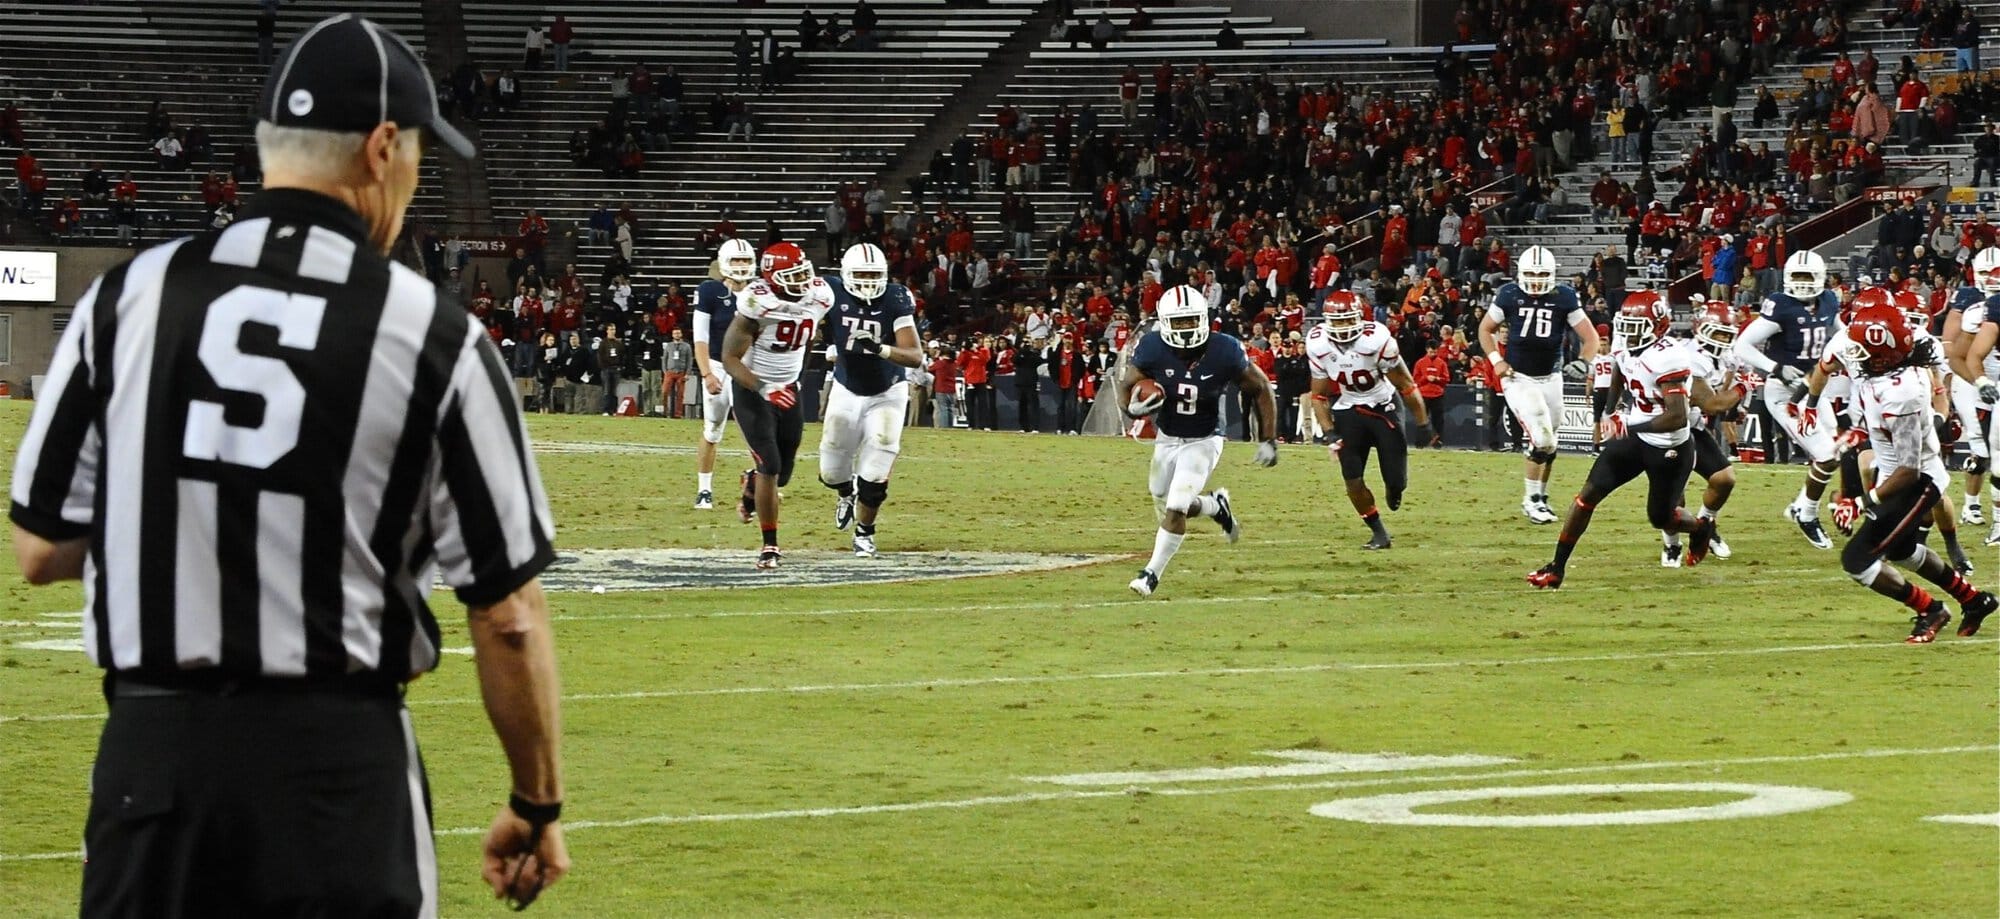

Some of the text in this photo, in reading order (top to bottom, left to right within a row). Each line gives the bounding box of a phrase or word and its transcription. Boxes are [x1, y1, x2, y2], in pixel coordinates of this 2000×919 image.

[771, 318, 814, 353] 90
[1518, 307, 1553, 338] 76
[1868, 328, 1884, 344] U
[1796, 326, 1827, 360] 18
[183, 284, 328, 470] S
[1336, 368, 1376, 393] 40
[1595, 362, 1612, 376] 95
[1176, 383, 1199, 415] 3
[1561, 409, 1594, 428] SINO
